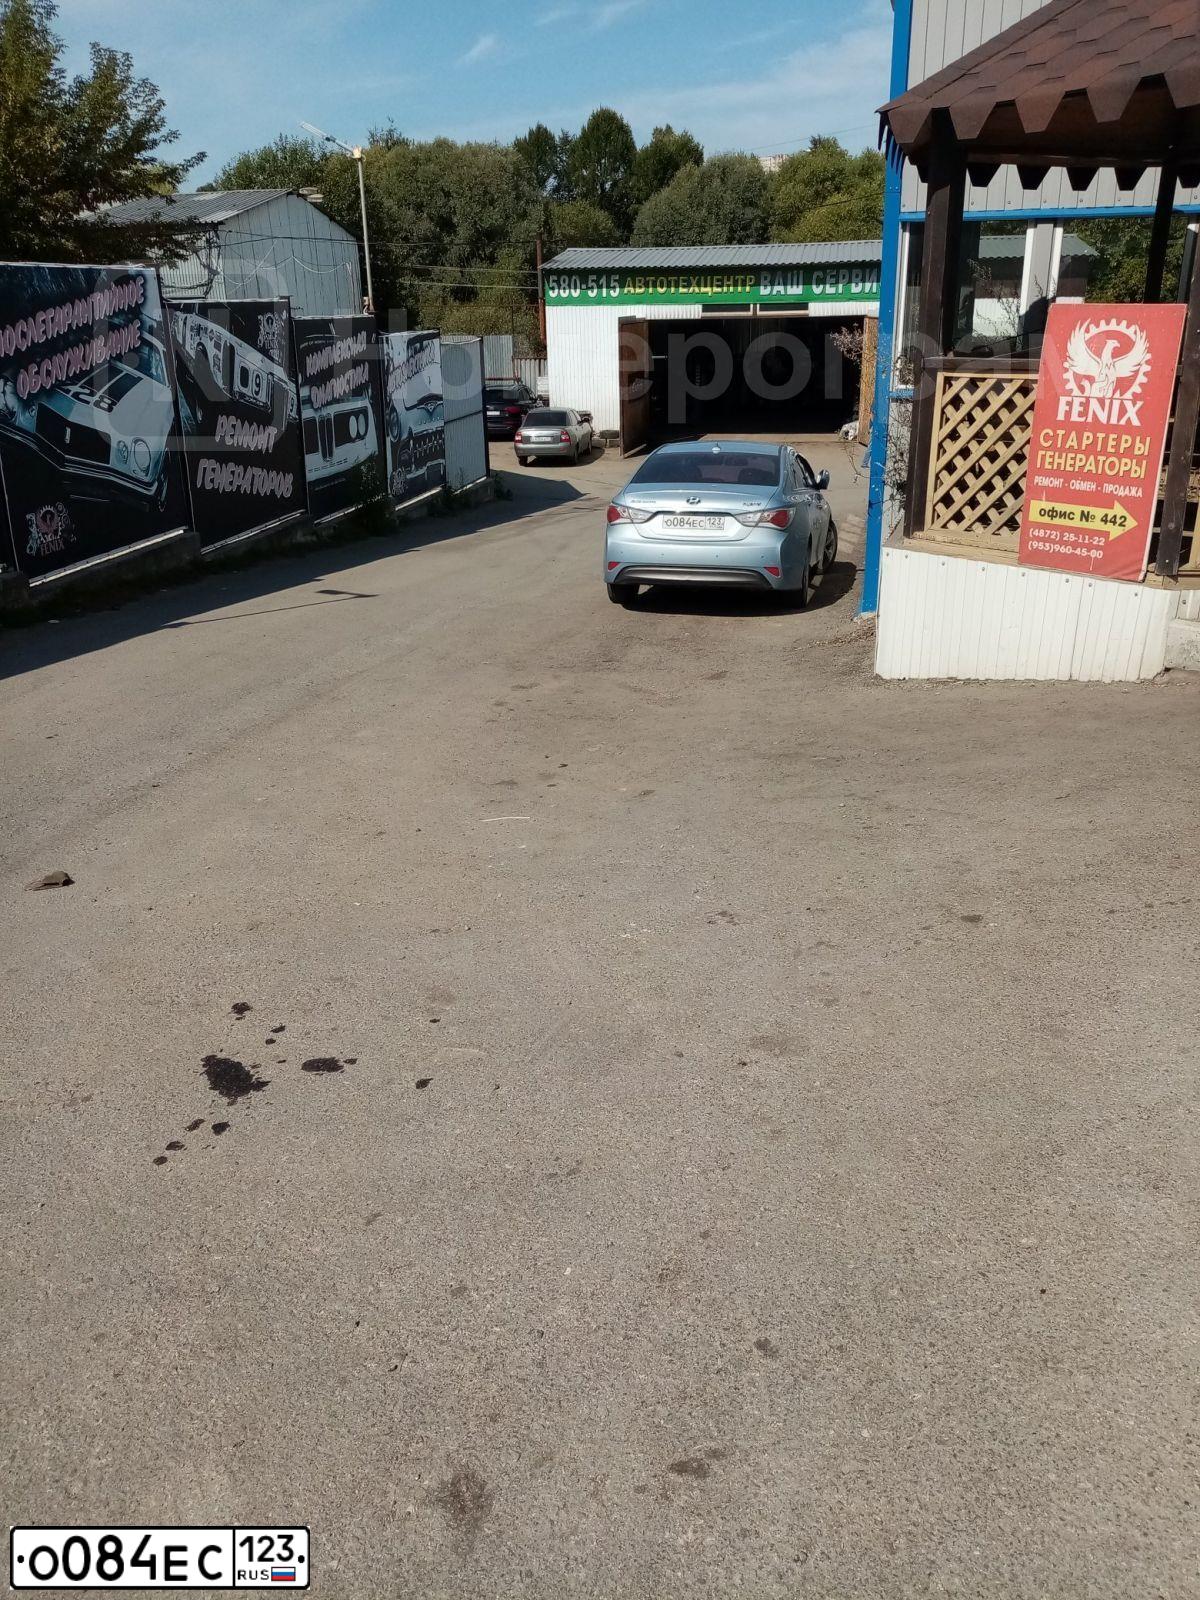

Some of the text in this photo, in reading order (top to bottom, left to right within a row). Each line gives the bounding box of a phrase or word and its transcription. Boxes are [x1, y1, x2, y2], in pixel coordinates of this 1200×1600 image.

[549, 266, 882, 298] 580-515 АВТОТЕХЦЕНТР ВАШ СЕРВИ
[17, 319, 142, 400] ОБСЛУЖИВАНИЕ
[1056, 395, 1144, 427] FENIX
[215, 414, 278, 453] РЕМОНТ
[1039, 428, 1151, 456] СТАРТЕРЫ
[196, 458, 294, 499] ГЕНЕРАТОРОВ
[1036, 450, 1147, 479] ГЕНЕРАТОРЫ
[1034, 475, 1064, 488] РЕМОНТ
[1069, 478, 1097, 492] ОБМЕН
[1103, 482, 1143, 498] ПРОДАЖА
[707, 516, 722, 526] 123
[1038, 506, 1127, 528] офис № 442
[1028, 540, 1104, 559] (953)960-45-00
[1029, 527, 1105, 546] (4872) 25-11-22
